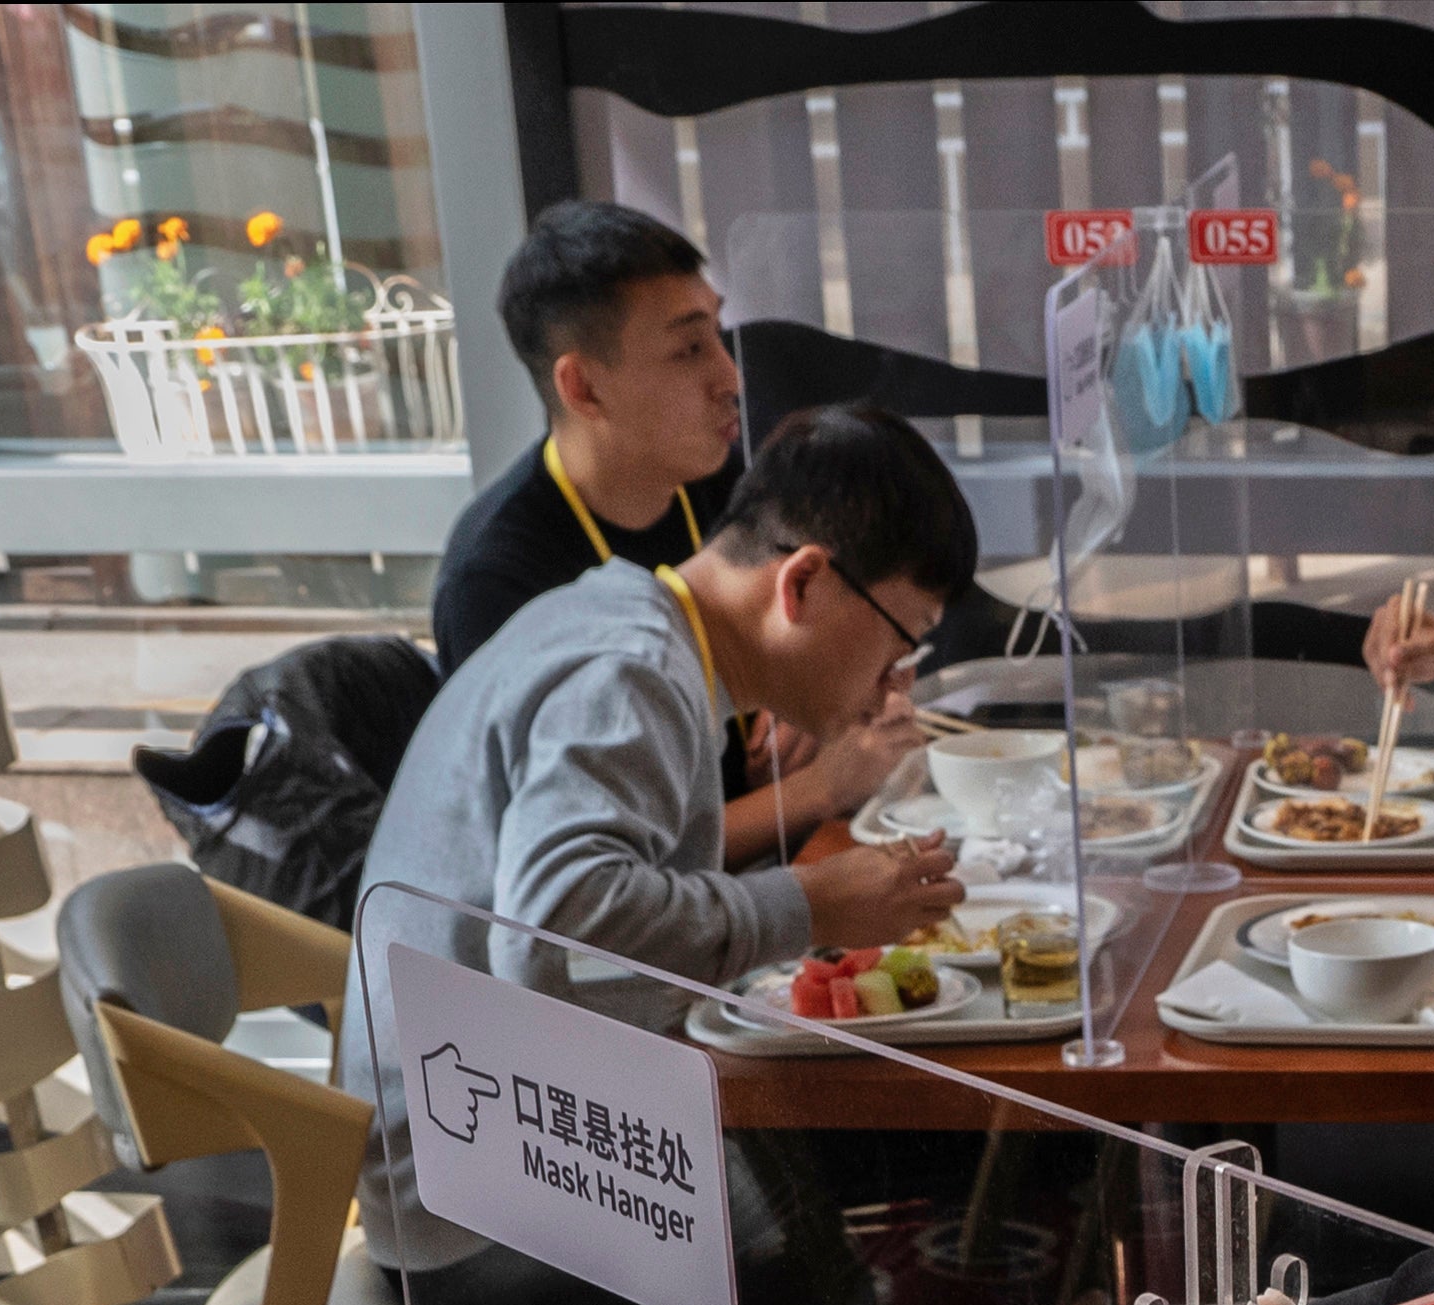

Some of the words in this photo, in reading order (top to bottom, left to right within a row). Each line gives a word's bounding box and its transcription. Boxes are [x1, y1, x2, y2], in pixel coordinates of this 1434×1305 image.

[1204, 219, 1270, 255] 055
[511, 1074, 696, 1195] 口罩悬挂处
[522, 1140, 593, 1203] Mask
[596, 1170, 696, 1244] Hanger
